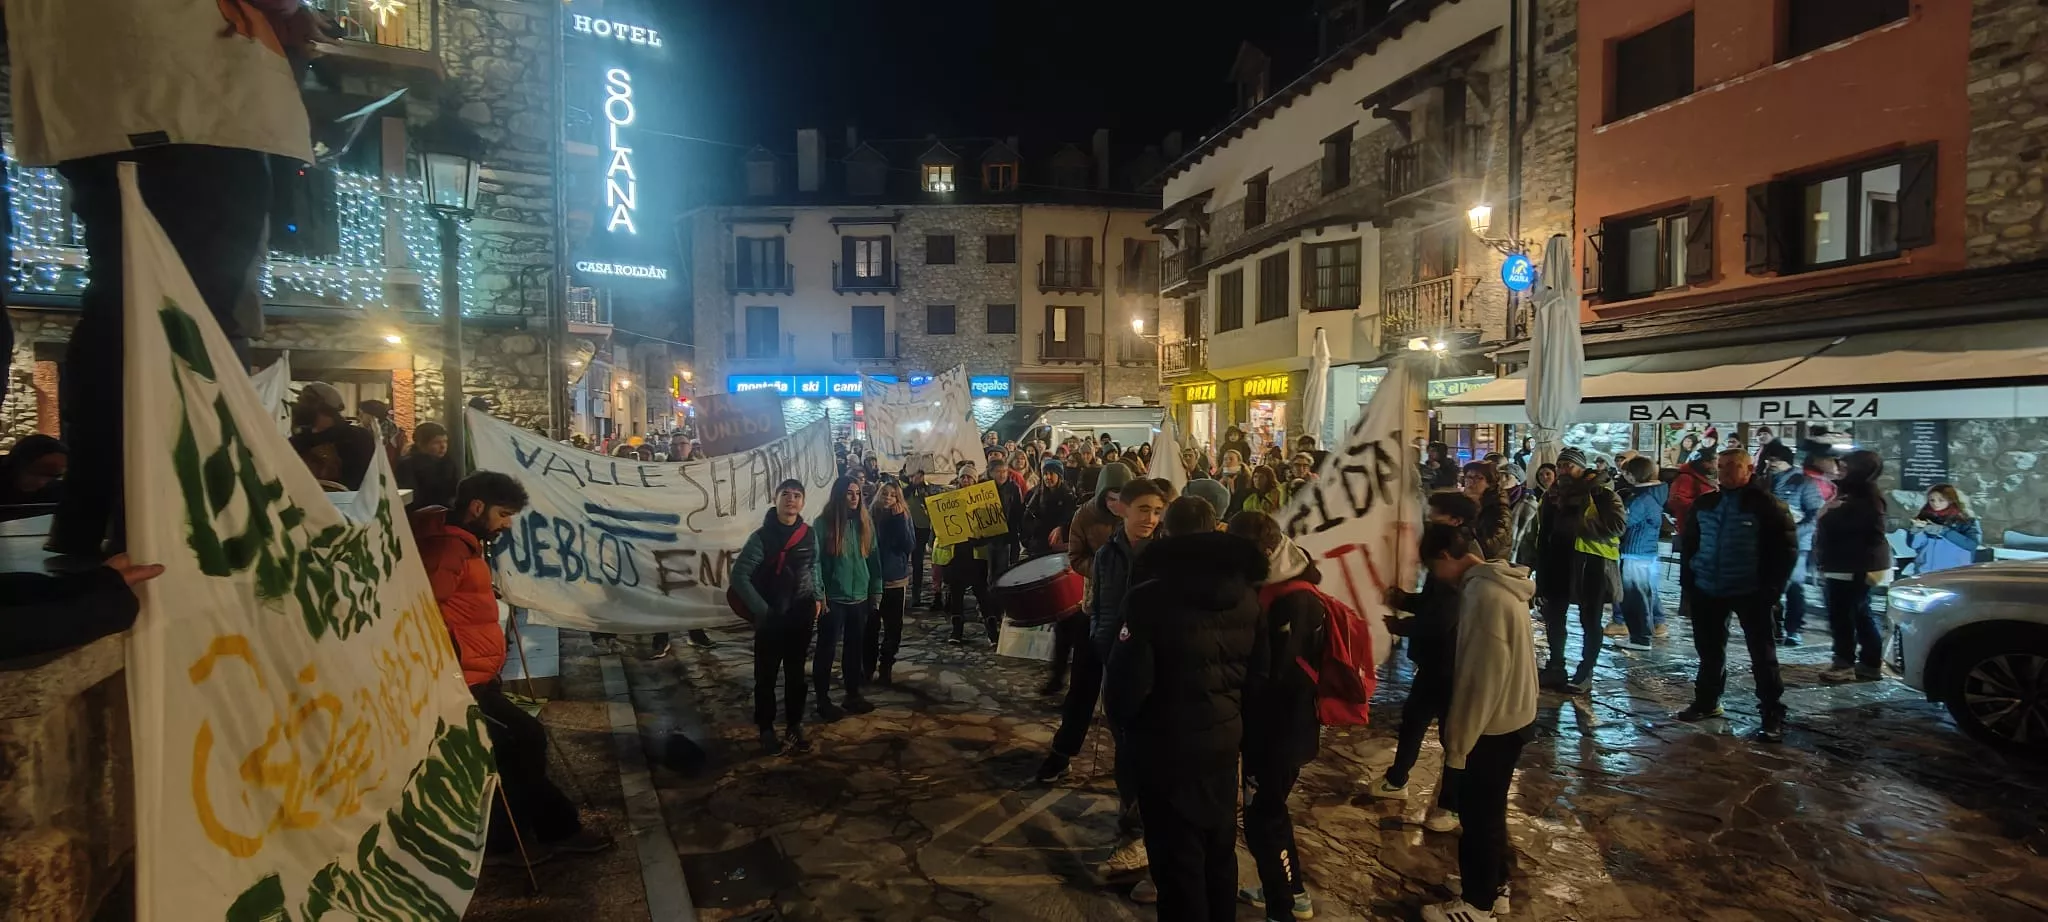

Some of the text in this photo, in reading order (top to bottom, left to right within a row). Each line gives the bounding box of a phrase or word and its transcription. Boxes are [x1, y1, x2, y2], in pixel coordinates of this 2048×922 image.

[573, 14, 662, 48] HOTEL
[604, 67, 636, 234] SOLANA
[576, 262, 667, 280] CASA ROLDÁN
[802, 381, 819, 392] ski
[971, 378, 1009, 393] regalos
[1244, 377, 1288, 396] PIRINE
[1629, 398, 1880, 421] BAR PLAZA
[510, 435, 666, 489] VALLE
[931, 489, 995, 513] Todos Juntos
[944, 503, 1006, 537] ES MEJOR
